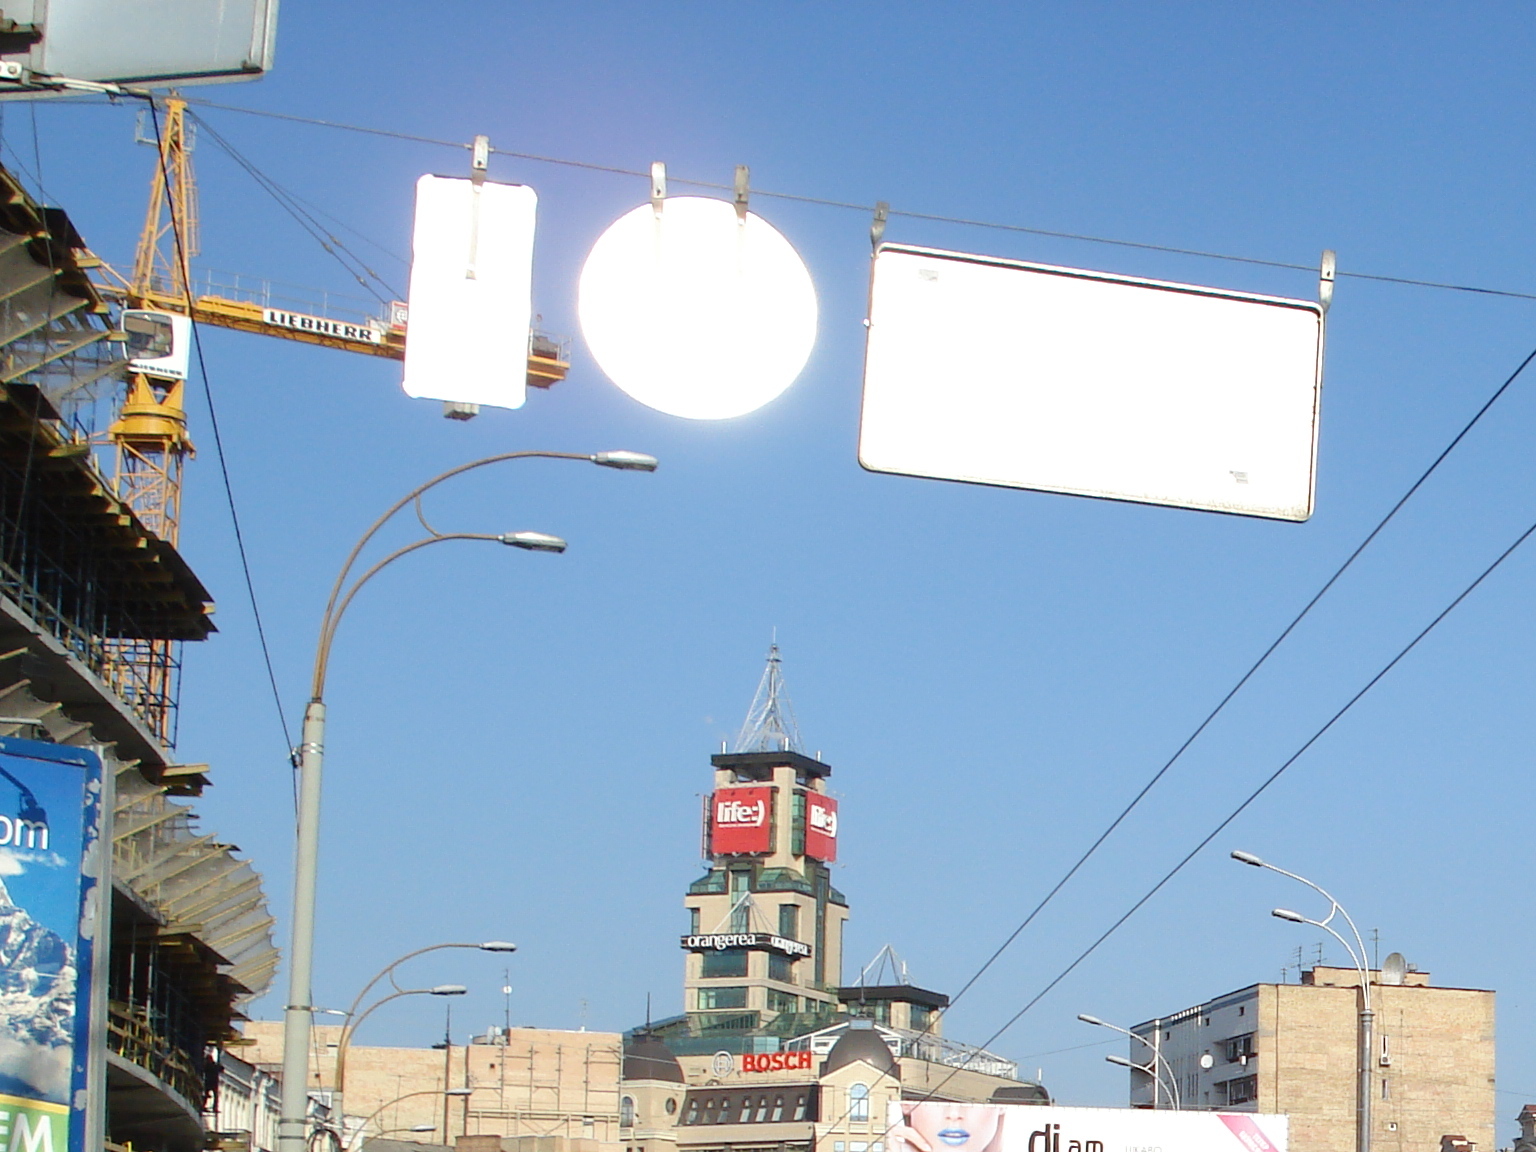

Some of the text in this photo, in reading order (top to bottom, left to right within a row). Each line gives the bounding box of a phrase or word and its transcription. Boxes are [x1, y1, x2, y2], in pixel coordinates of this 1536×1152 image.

[269, 311, 373, 341] LIEBHERR
[687, 934, 756, 950] orangerea
[742, 1051, 812, 1073] BOSCH
